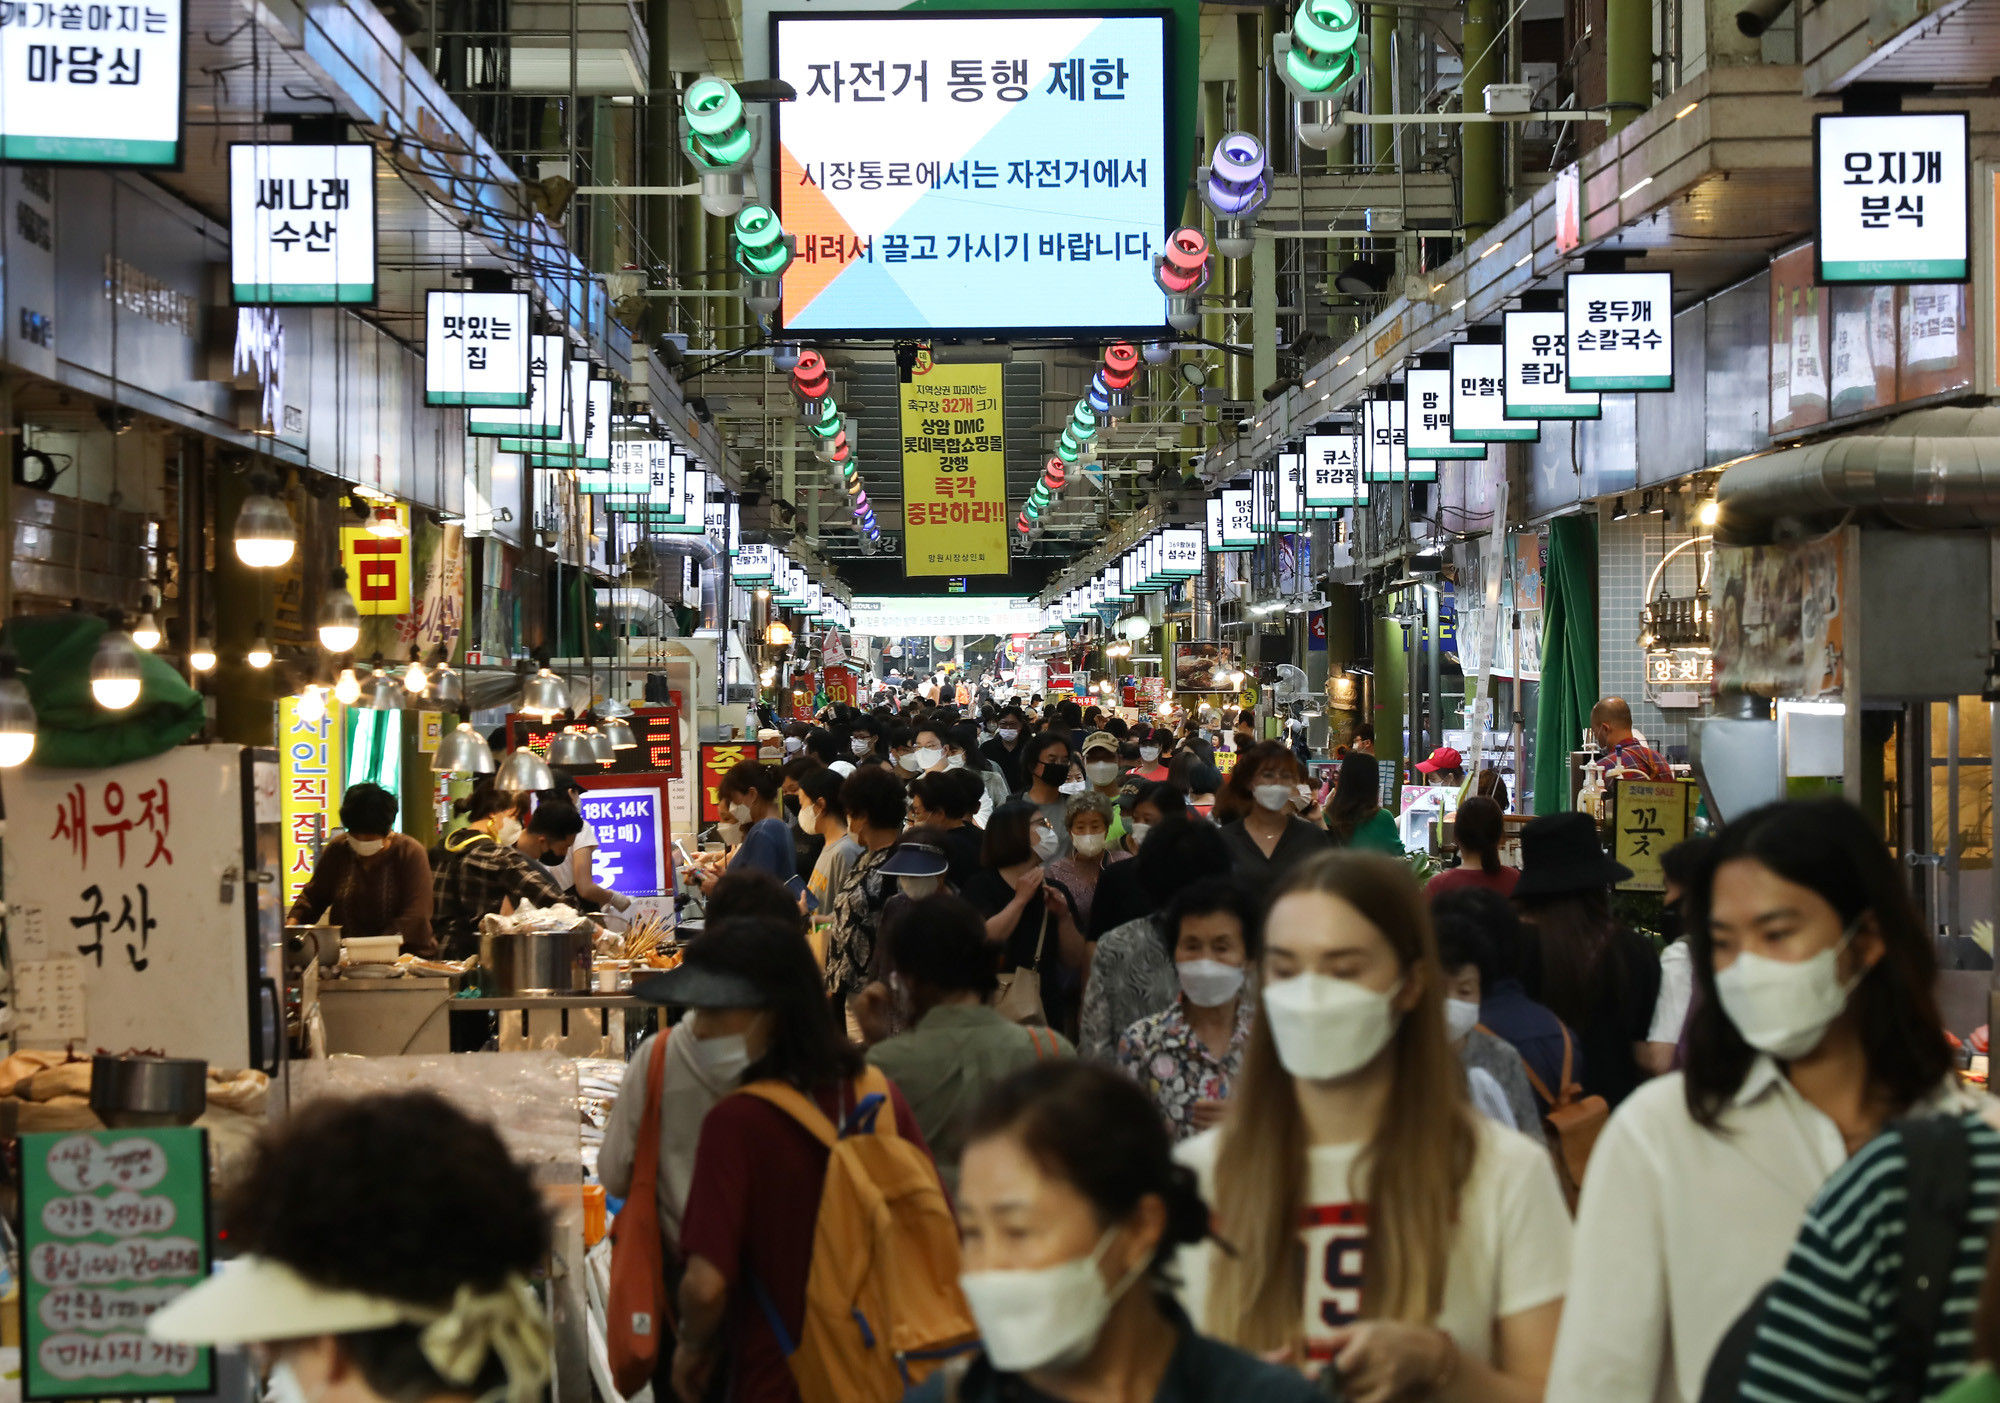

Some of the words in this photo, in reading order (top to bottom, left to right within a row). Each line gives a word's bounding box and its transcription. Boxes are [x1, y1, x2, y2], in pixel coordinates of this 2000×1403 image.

[28, 44, 141, 86] 마당쇠
[806, 59, 929, 103] 자전거
[946, 59, 1029, 103] 통행
[1046, 57, 1129, 101] 제한
[799, 160, 999, 191] 시장통로에서는
[1006, 158, 1147, 189] 자전거에서
[1843, 150, 1942, 186] 오지개
[256, 177, 350, 211] 새나래
[1860, 195, 1924, 229] 분식
[269, 220, 337, 253] 수산
[793, 233, 874, 264] 내려서
[881, 233, 939, 263] 끌고
[946, 233, 1030, 263] 가시기
[1587, 300, 1652, 323] 홍두깨
[443, 316, 511, 341] 맛있는
[1577, 329, 1663, 352] 손칼국수
[467, 347, 487, 370] 집
[916, 384, 950, 396] 지역상권
[952, 384, 987, 395] 파괴하는
[908, 399, 939, 414] 축구장
[941, 398, 973, 414] 32개
[976, 398, 997, 412] 크기
[921, 418, 951, 436] 상암
[954, 417, 985, 435] DMC
[904, 435, 1003, 454] 롯데복합쇼핑몰
[939, 456, 969, 473] 강행
[935, 476, 977, 498] 즉각
[907, 502, 1005, 526] 중단하라!!
[928, 553, 986, 563] 망원시장상인회
[1655, 787, 1675, 797] SALE
[50, 778, 173, 872] 새우젓
[1623, 807, 1666, 857] 꽃
[69, 883, 157, 973] 국산
